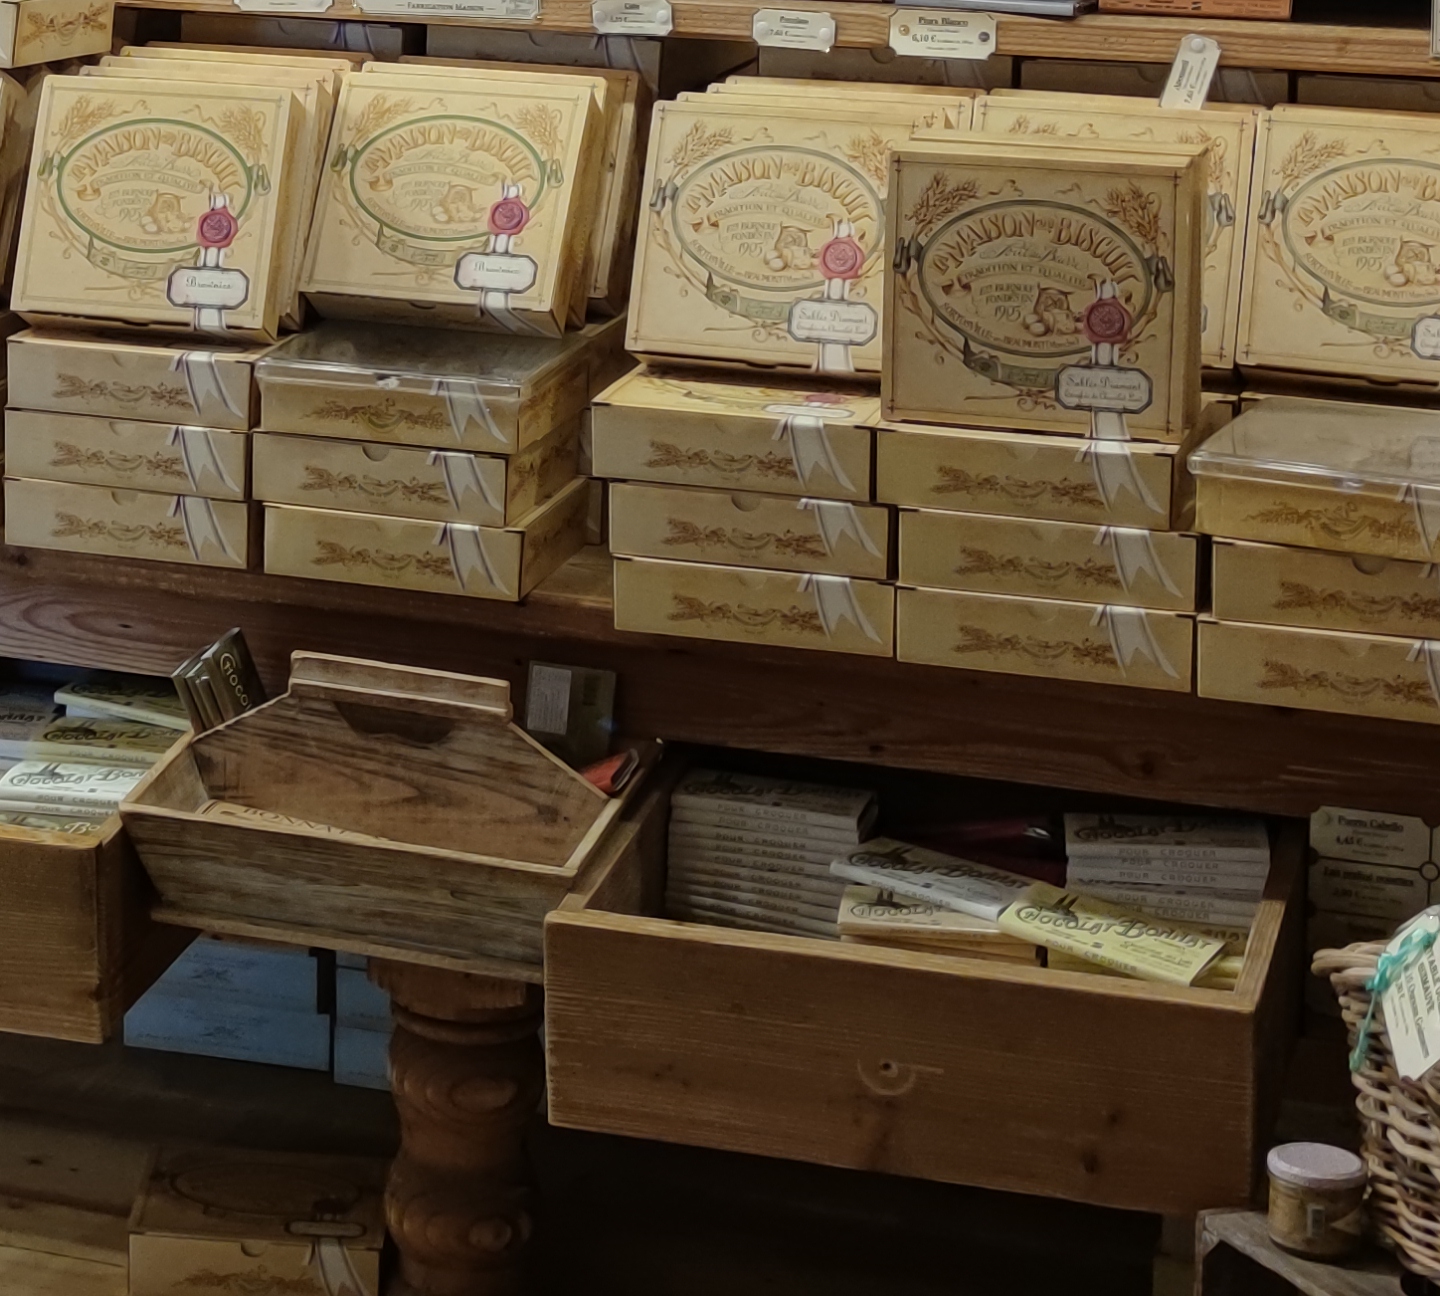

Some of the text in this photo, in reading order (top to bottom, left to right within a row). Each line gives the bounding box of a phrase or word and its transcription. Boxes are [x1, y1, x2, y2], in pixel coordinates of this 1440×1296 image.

[693, 156, 783, 205] MAISON
[799, 159, 877, 227] BISCUIT
[1307, 168, 1401, 220] MAISON
[942, 211, 1036, 266] MAISON
[1053, 211, 1140, 285] BISCUIT
